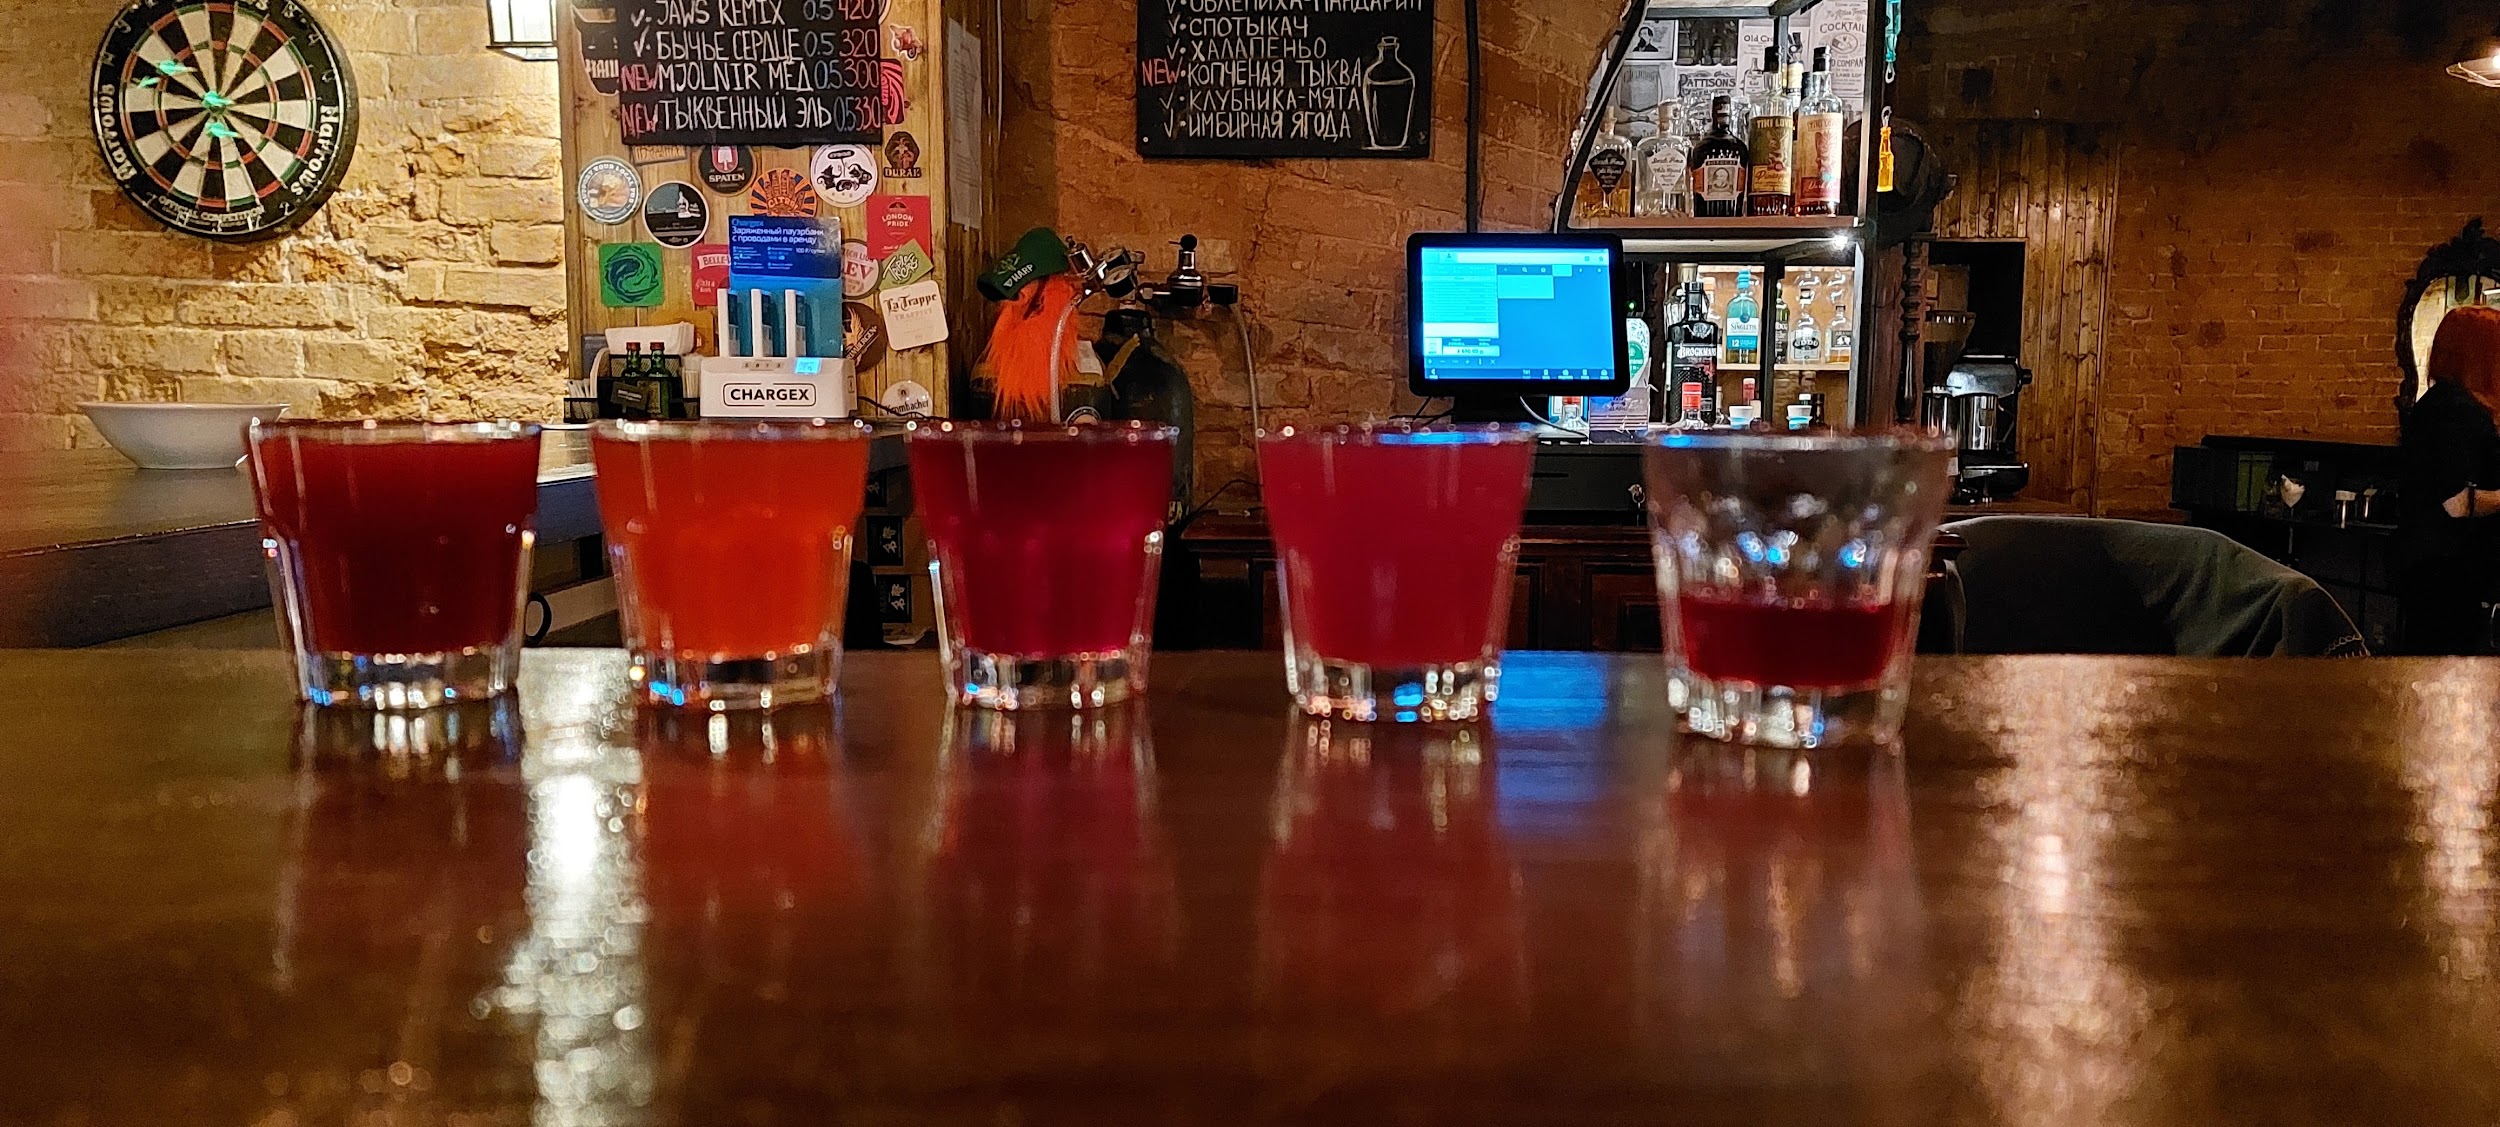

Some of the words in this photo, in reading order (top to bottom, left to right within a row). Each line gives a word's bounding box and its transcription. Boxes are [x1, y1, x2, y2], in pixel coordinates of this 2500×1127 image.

[655, 0, 710, 27] JAWS
[719, 0, 785, 27] REMIX
[1189, 16, 1308, 38] СПОТЫКАЧ
[1820, 22, 1866, 33] COCKTAIL
[656, 30, 729, 61] БЫЧЬЕ
[733, 28, 803, 64] СЕРДЦЕ
[804, 31, 836, 57] 0.5
[839, 29, 878, 57] 320
[1191, 37, 1327, 62] ХАЛАПЕНЬО
[620, 63, 657, 92] NEW
[844, 60, 879, 90] 300
[1142, 56, 1182, 87] NEW
[1188, 59, 1284, 87] КОПЧЕНАЯ
[1295, 57, 1362, 87] ТЫКВА
[1680, 74, 1736, 88] PATTISONS
[622, 103, 659, 138] NEW
[659, 92, 787, 131] ТЫКВЕННЫЙ
[795, 97, 832, 129] ЭЛЬ
[855, 96, 880, 131] 330
[1189, 110, 1283, 139] ИМБИРНАЯ
[1291, 109, 1351, 143] ЯГОДА
[290, 105, 338, 196] Harrows
[708, 173, 745, 183] SPATEN
[882, 213, 914, 223] LONDON
[732, 226, 782, 236] Заряженный
[783, 227, 824, 237] пауэрбанк
[738, 235, 782, 243] проводами
[789, 236, 817, 245] аренду
[845, 261, 874, 279] EV
[1011, 264, 1033, 282] HARP
[883, 298, 899, 313] La
[900, 293, 937, 310] Trappe
[1731, 339, 1740, 347] 12
[730, 389, 809, 400] CHARGEX
